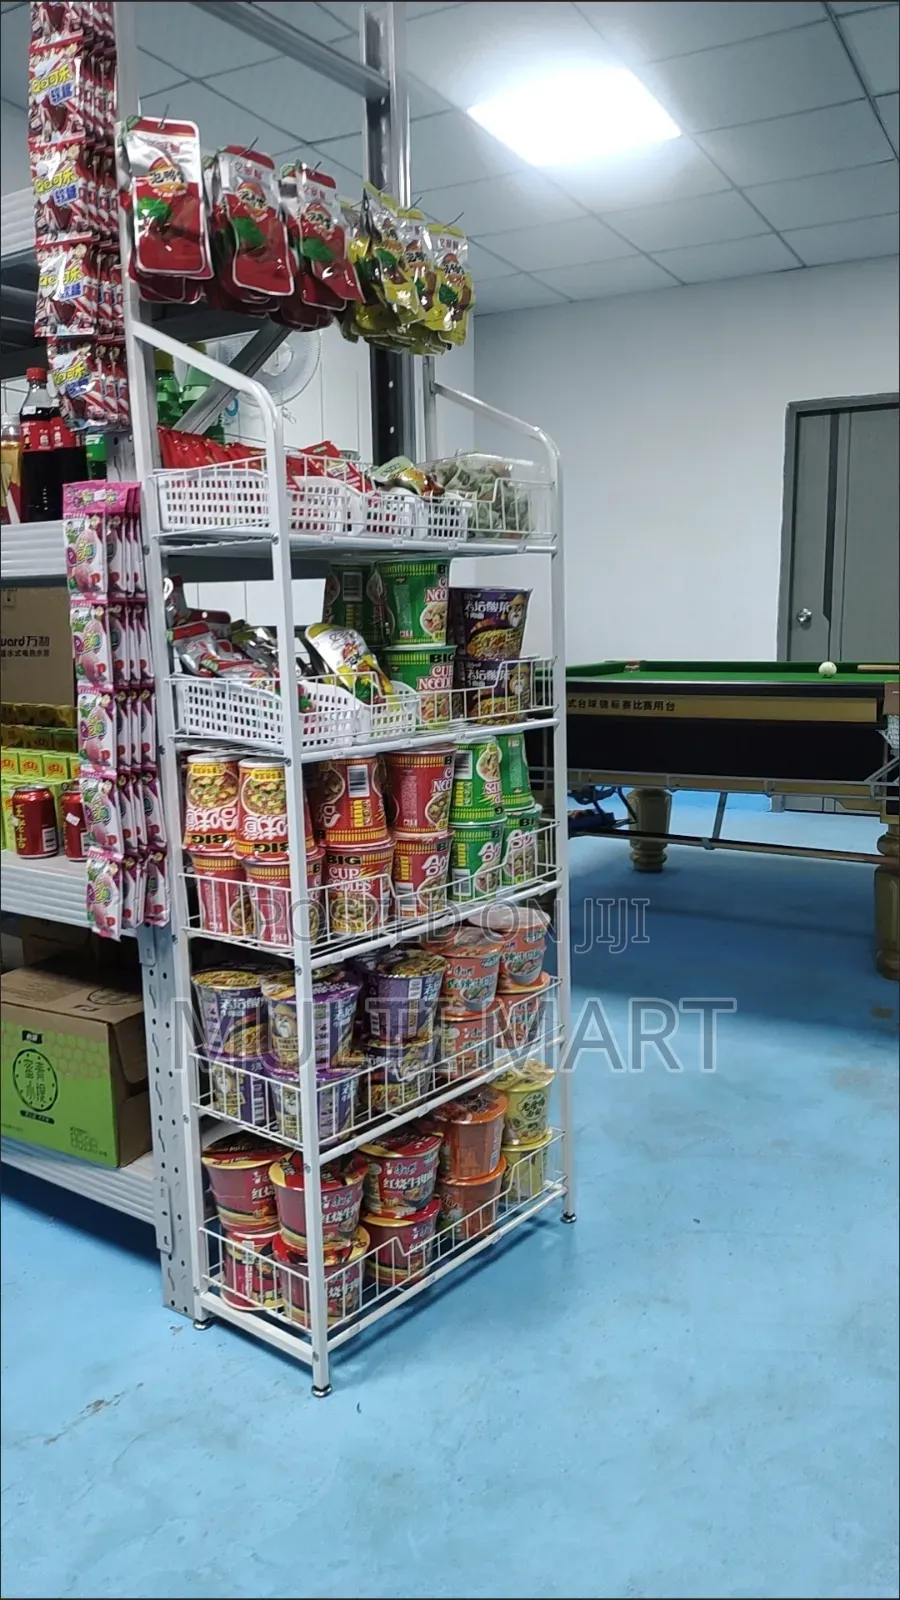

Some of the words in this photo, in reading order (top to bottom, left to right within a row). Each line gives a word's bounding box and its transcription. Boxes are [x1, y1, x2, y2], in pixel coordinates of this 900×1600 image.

[431, 664, 453, 678] CU
[327, 854, 361, 865] BIG
[329, 866, 361, 880] CUP
